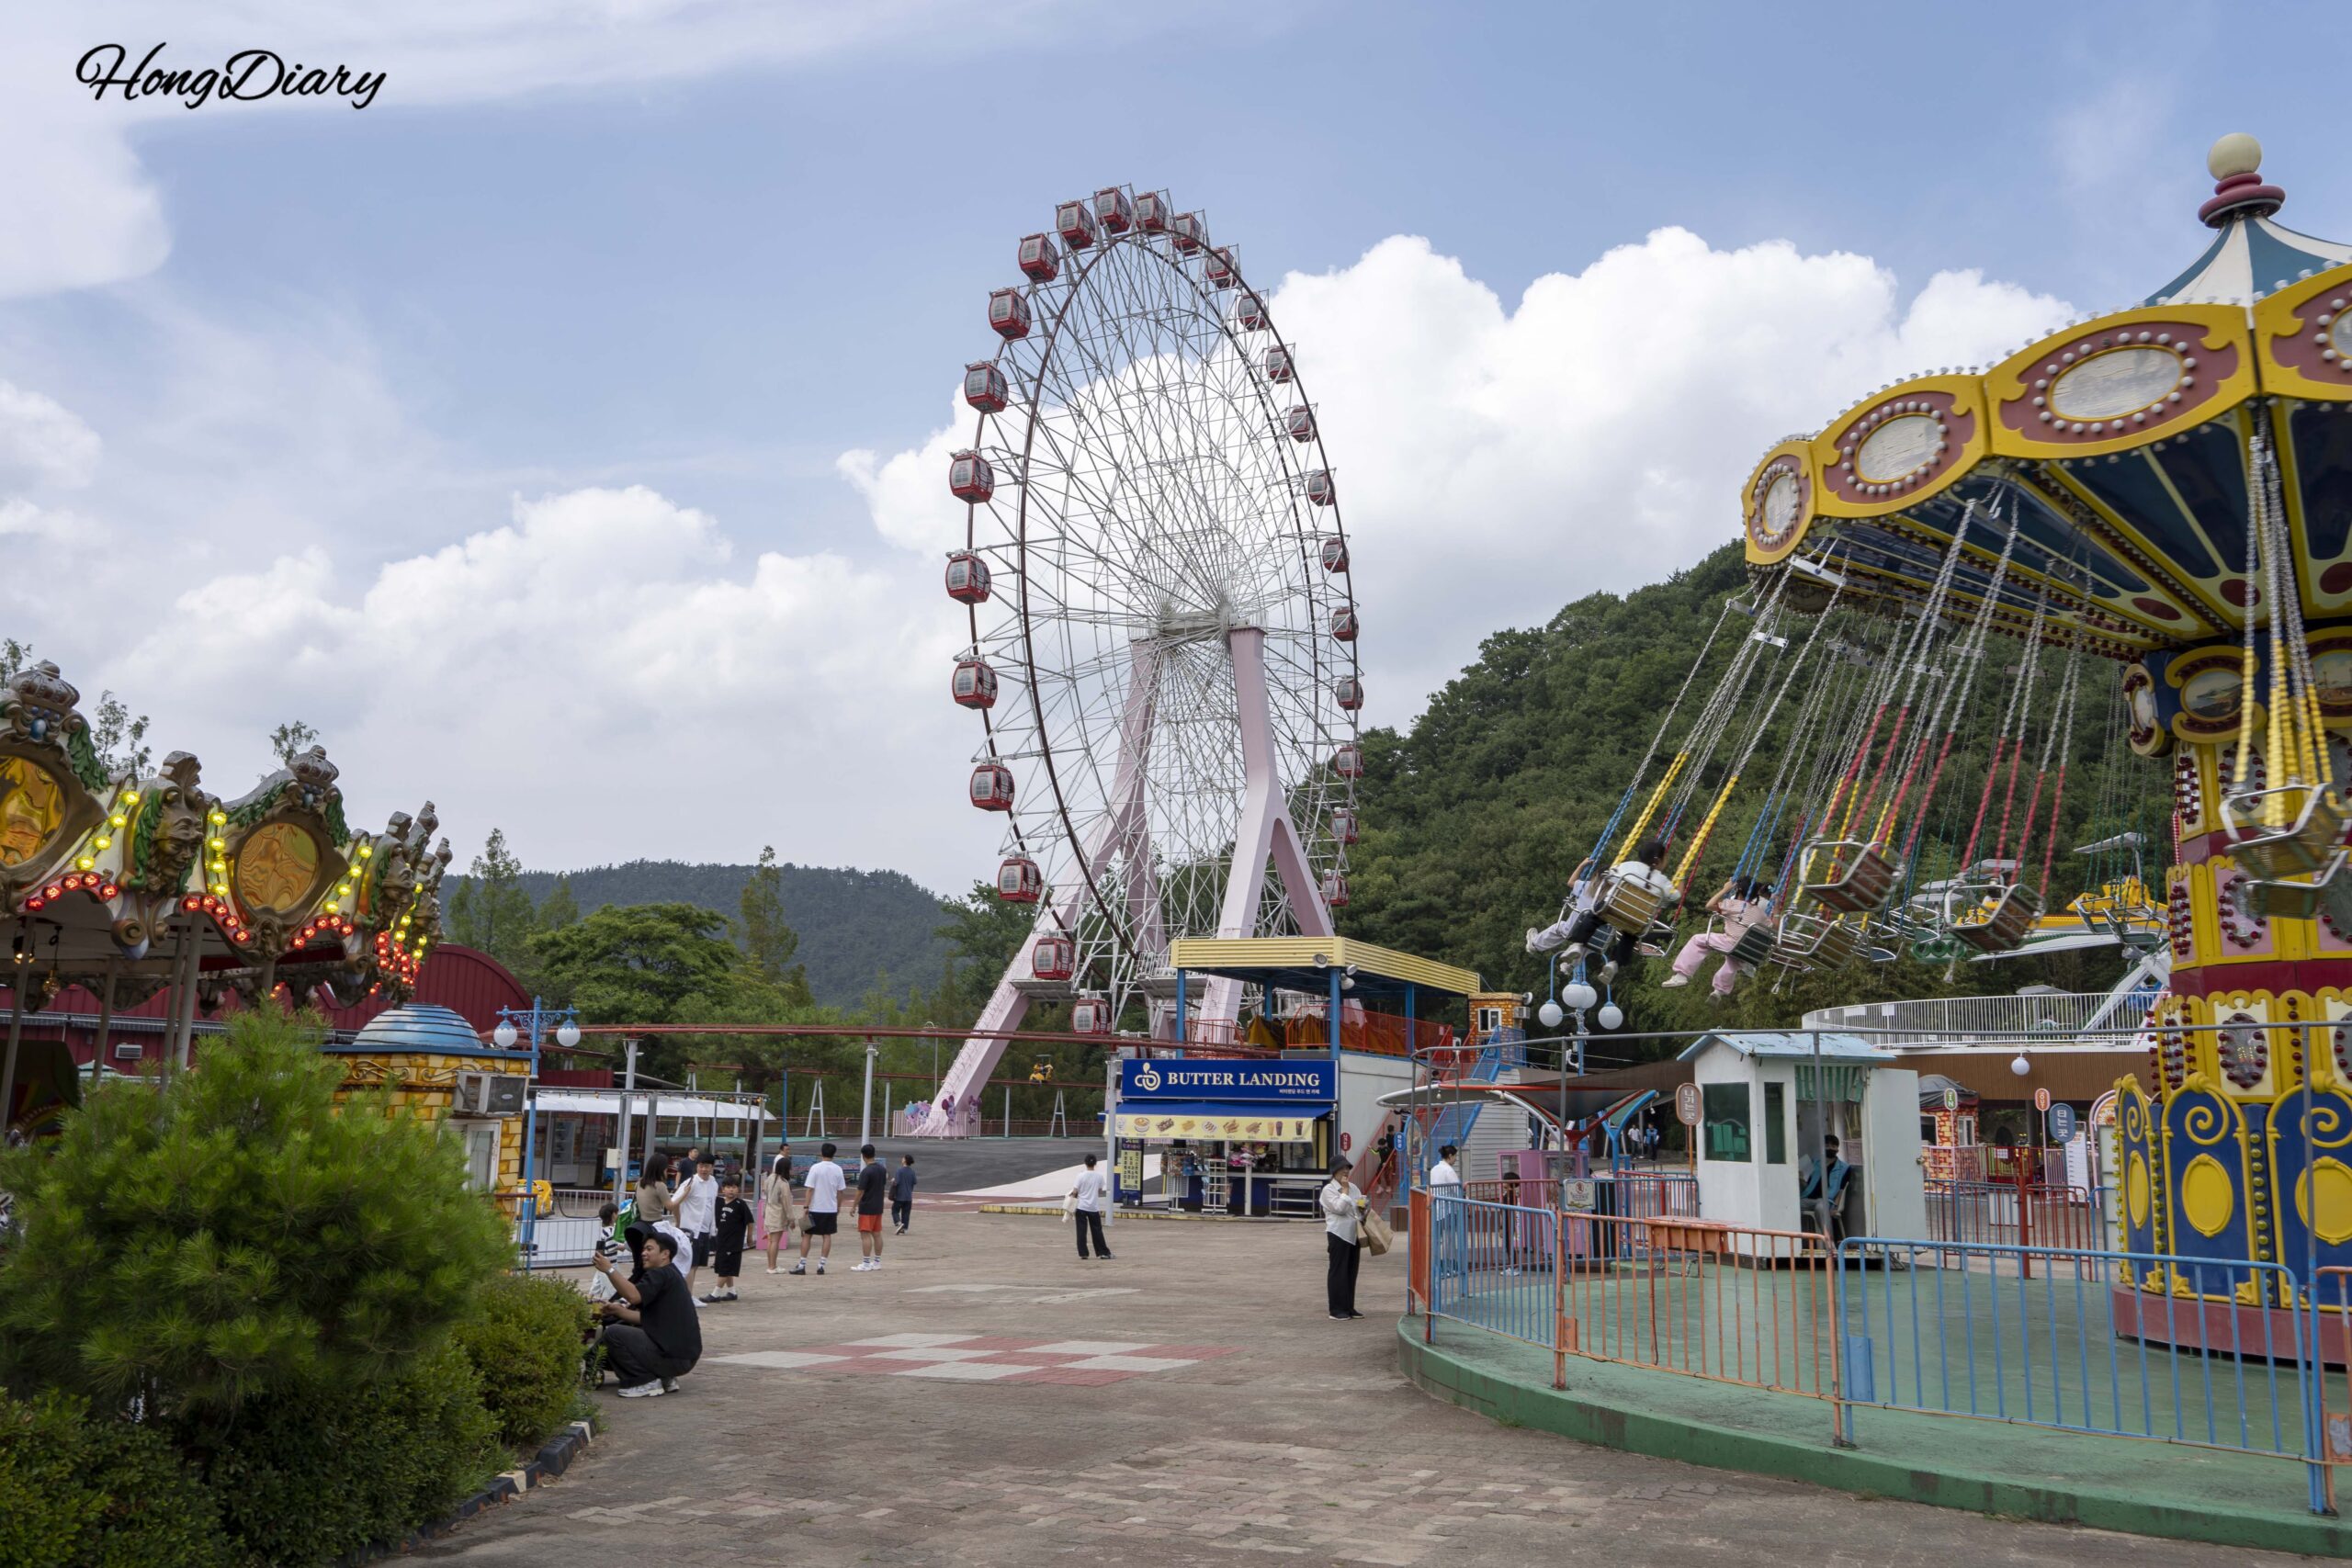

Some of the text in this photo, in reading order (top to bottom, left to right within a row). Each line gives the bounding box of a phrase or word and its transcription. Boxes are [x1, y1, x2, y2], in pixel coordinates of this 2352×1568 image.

[1167, 1072, 1320, 1086] BUTTER LANDING
[1684, 1089, 1695, 1120] 나가는곳
[2057, 1110, 2069, 1137] 타는곳
